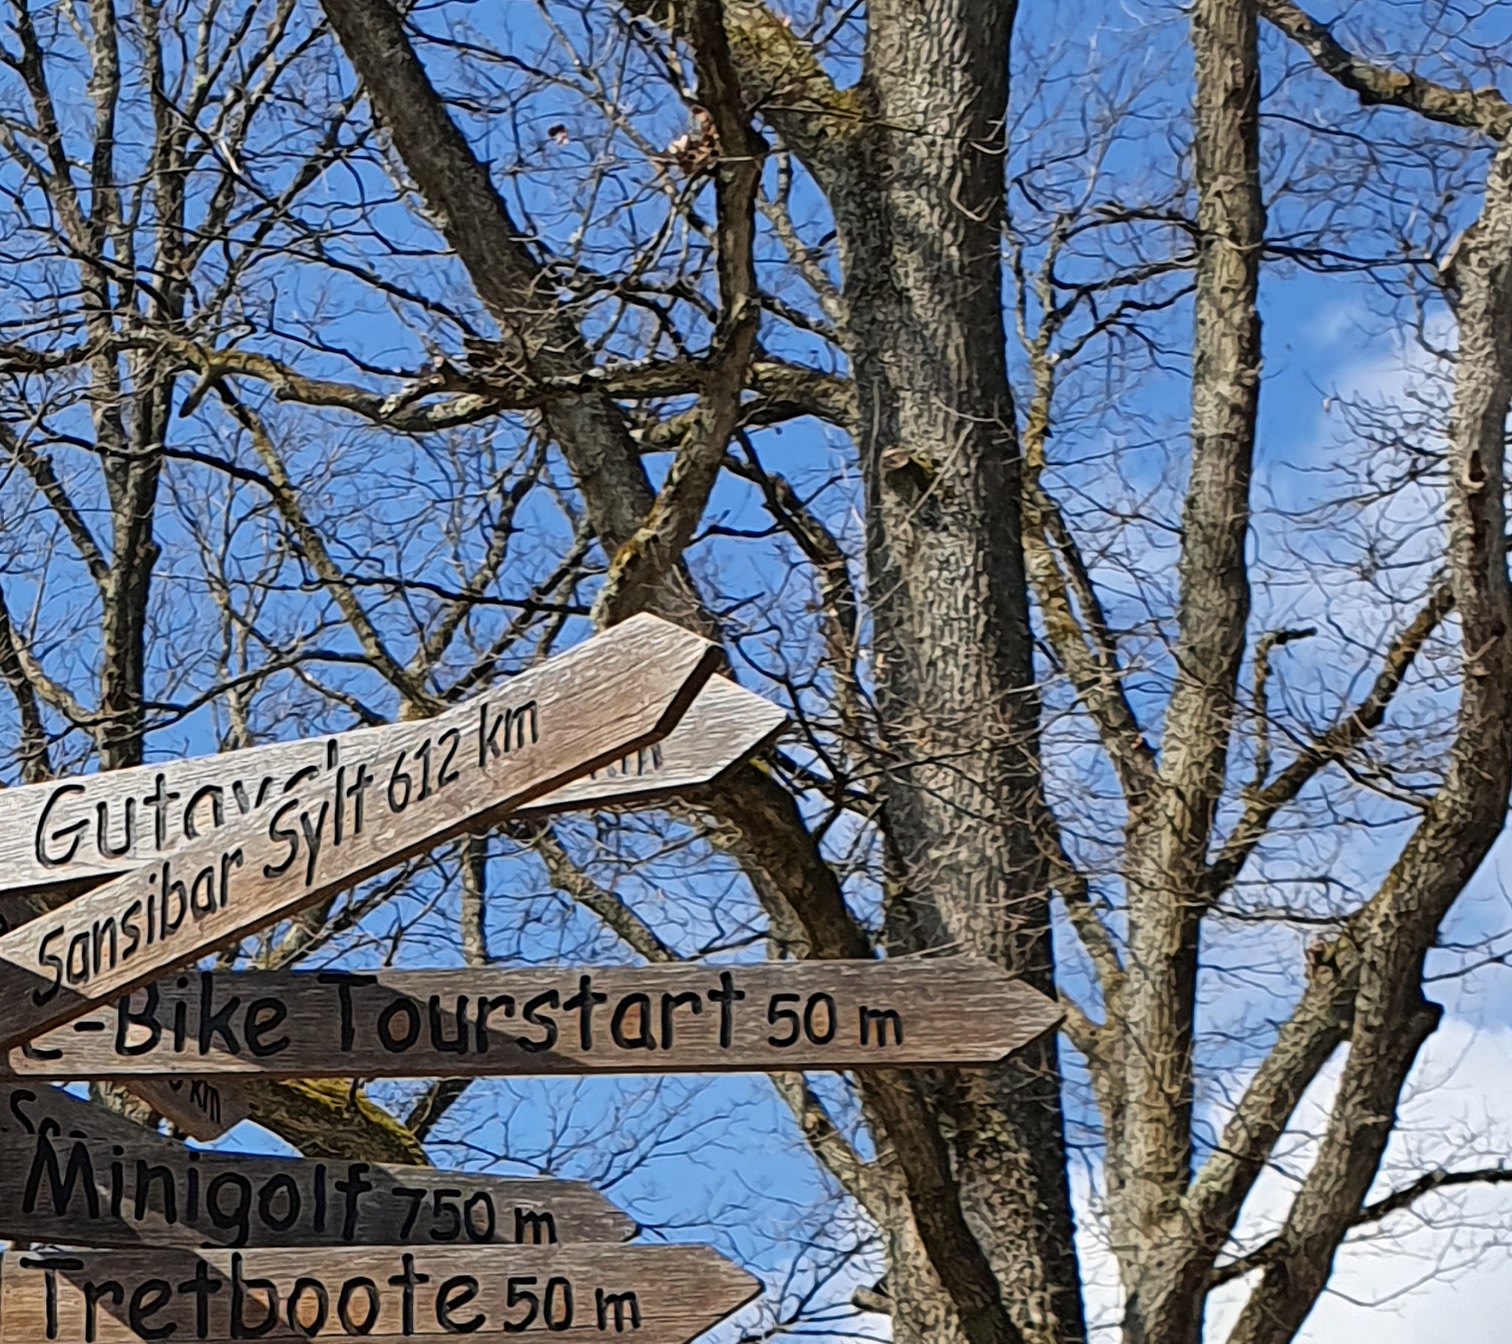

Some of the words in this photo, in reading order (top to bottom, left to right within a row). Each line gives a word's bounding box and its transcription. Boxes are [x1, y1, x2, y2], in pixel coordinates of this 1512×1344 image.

[33, 848, 243, 1006] Sansibar
[263, 764, 374, 886] Sylt
[388, 728, 461, 813] 612
[479, 700, 539, 768] km
[21, 971, 290, 1057] -Bike
[318, 970, 746, 1054] Tourstart
[766, 1000, 835, 1047] 50
[858, 1003, 904, 1047] m
[22, 1138, 369, 1247] Minigolf
[394, 1190, 492, 1244] 750
[514, 1204, 558, 1246] m
[19, 1251, 488, 1342] Tretboote
[504, 1275, 575, 1333] 50
[595, 1279, 643, 1333] m
